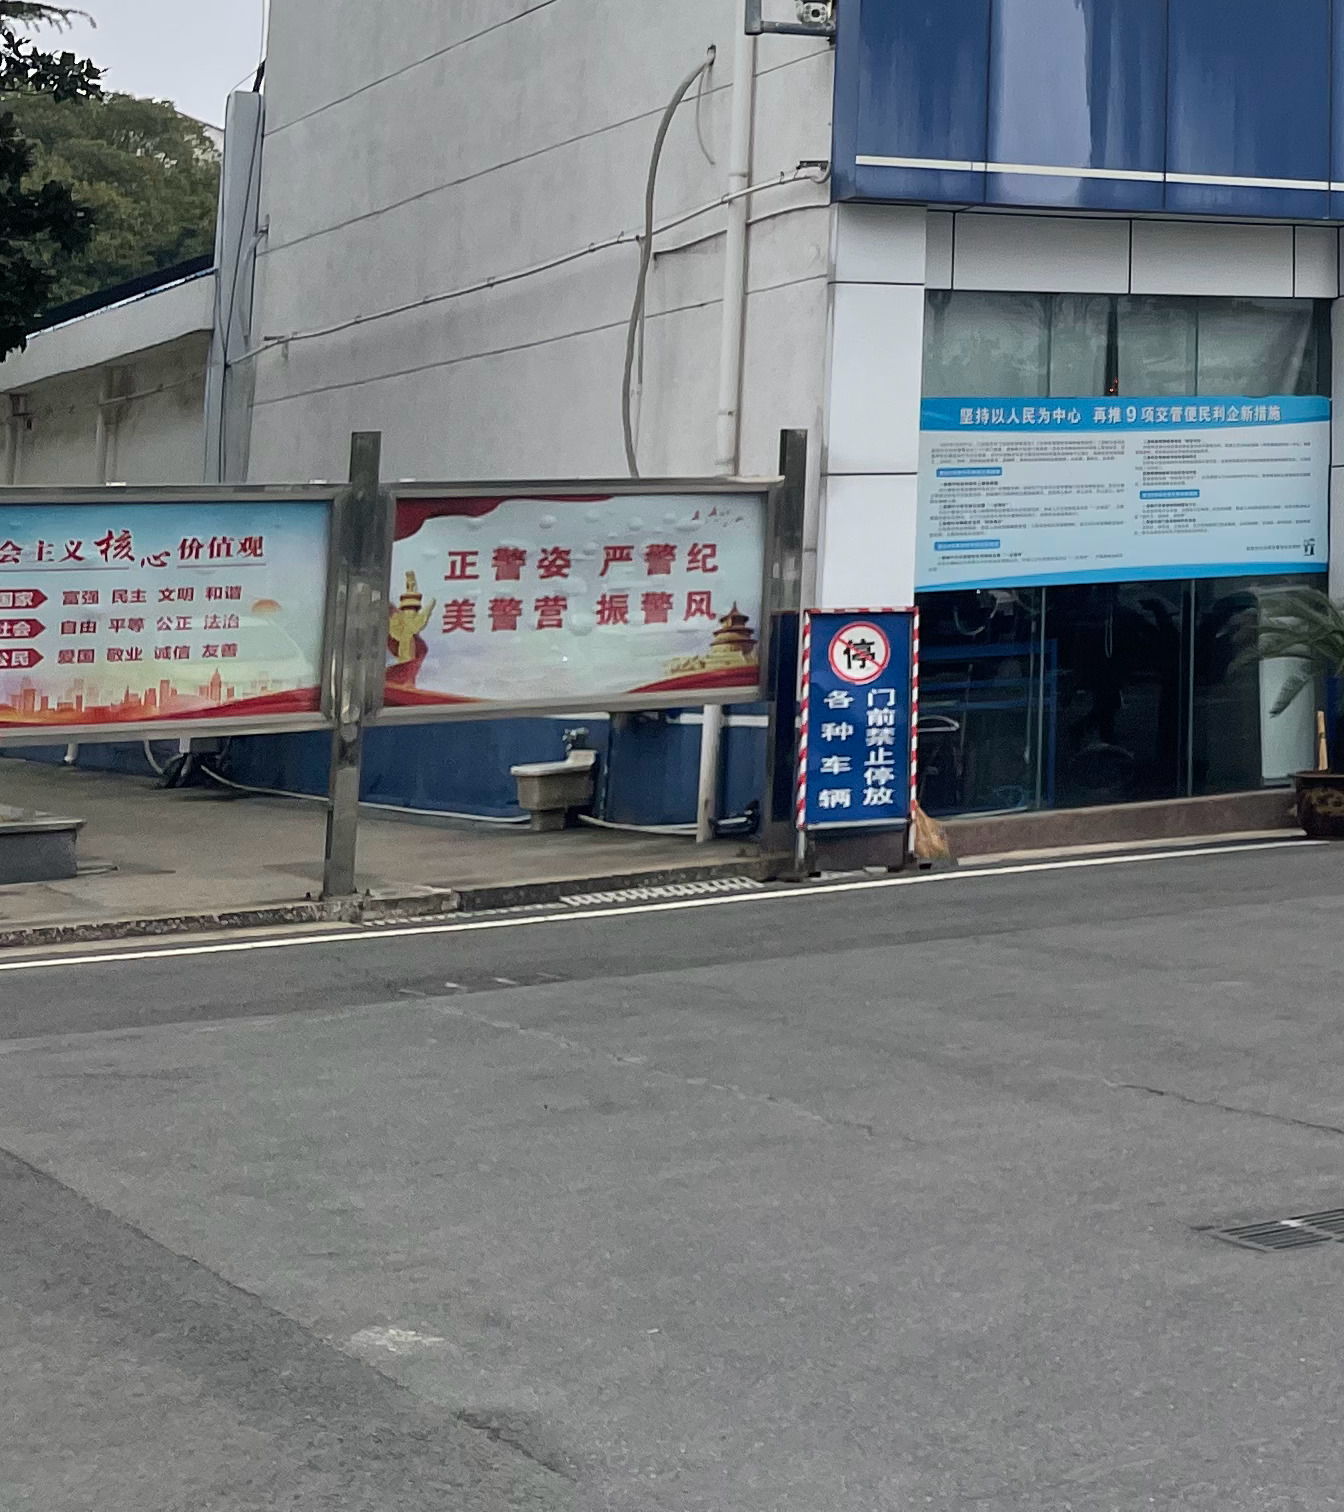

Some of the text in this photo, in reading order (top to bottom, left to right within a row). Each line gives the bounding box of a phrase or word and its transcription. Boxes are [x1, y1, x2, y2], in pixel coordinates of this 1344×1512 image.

[959, 406, 1082, 425] 坚持以人民为中心
[444, 542, 719, 581] 正警姿 严警纪
[62, 590, 99, 605] 富强
[112, 588, 147, 604] 民主
[158, 586, 195, 602] 文明
[205, 585, 242, 601] 和谐
[60, 620, 97, 635] 自由
[107, 618, 145, 633] 平等
[156, 615, 193, 632] 公正
[203, 614, 240, 630] 法治
[442, 590, 717, 634] 美警营 振警风
[57, 648, 95, 664] 爱国
[107, 646, 143, 662] 敬业
[154, 645, 190, 660] 诚信
[202, 643, 238, 658] 友善
[843, 639, 875, 669] 停
[818, 689, 854, 808] 各种车辆
[862, 688, 896, 806] 门前禁止停放
